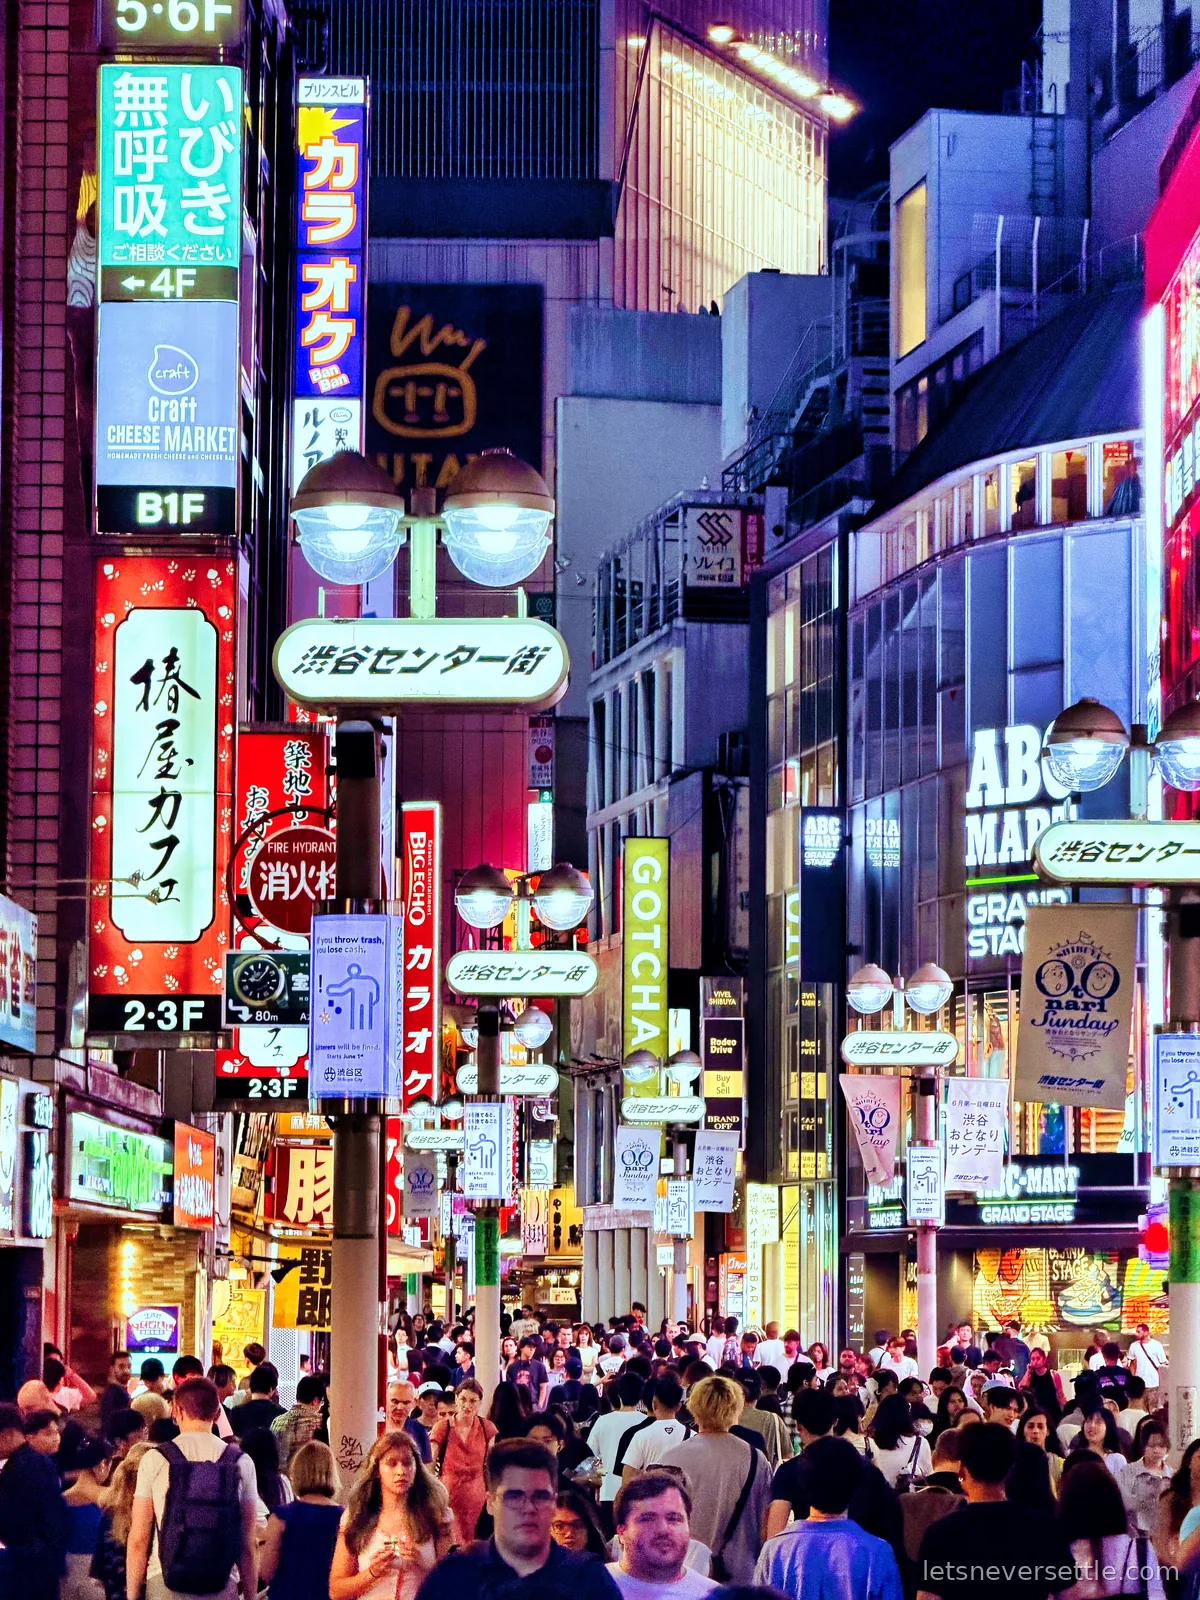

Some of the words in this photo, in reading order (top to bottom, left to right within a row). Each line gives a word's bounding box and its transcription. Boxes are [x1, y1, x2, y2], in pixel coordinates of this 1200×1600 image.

[304, 83, 360, 98] プリンスビル
[113, 71, 168, 238] 無呼吸
[179, 72, 236, 236] いびき
[112, 243, 232, 262] ご相談ください
[301, 137, 359, 365] カラオケ
[150, 268, 196, 297] 4F
[155, 364, 190, 379] craft
[309, 364, 341, 384] Ban
[319, 374, 350, 393] Ban
[148, 396, 197, 423] Craft
[107, 425, 160, 443] CHEESE
[164, 426, 236, 453] MARKET
[138, 492, 204, 524] B1F
[292, 645, 553, 675] 渋谷センター街
[130, 647, 200, 903] 椿屋カフェ
[804, 816, 840, 835] ABC
[268, 842, 289, 853] FIRE
[804, 834, 840, 848] MART
[409, 832, 427, 868] BIG
[409, 872, 426, 926] ECHO
[334, 936, 358, 944] throw
[361, 936, 384, 945] trash,
[631, 856, 661, 1046] GOTCHA
[455, 965, 591, 981] 渋谷センター街
[709, 998, 736, 1006] SHIBUYA
[1045, 999, 1107, 1012] nari
[255, 1011, 278, 1021] 80m
[405, 945, 432, 1095] カラオケ
[1031, 1010, 1119, 1037] Sunday
[710, 1038, 737, 1047] Rodeo
[710, 1046, 733, 1054] Drive
[849, 1041, 951, 1055] 渋谷センター街
[337, 1068, 363, 1077] 渋谷区
[716, 1074, 730, 1084] Buy
[716, 1086, 730, 1095] Sell
[714, 1122, 733, 1130] OFF
[962, 1113, 989, 1126] 渋谷
[949, 1129, 999, 1142] おとなり
[948, 1144, 999, 1157] サンデー
[705, 1155, 725, 1164] 渋谷
[696, 1167, 732, 1176] おとなり
[696, 1177, 731, 1187] サンデー
[982, 1206, 1030, 1223] GRAND
[1031, 1205, 1075, 1221] STAGE
[1052, 1256, 1089, 1281] STAGE
